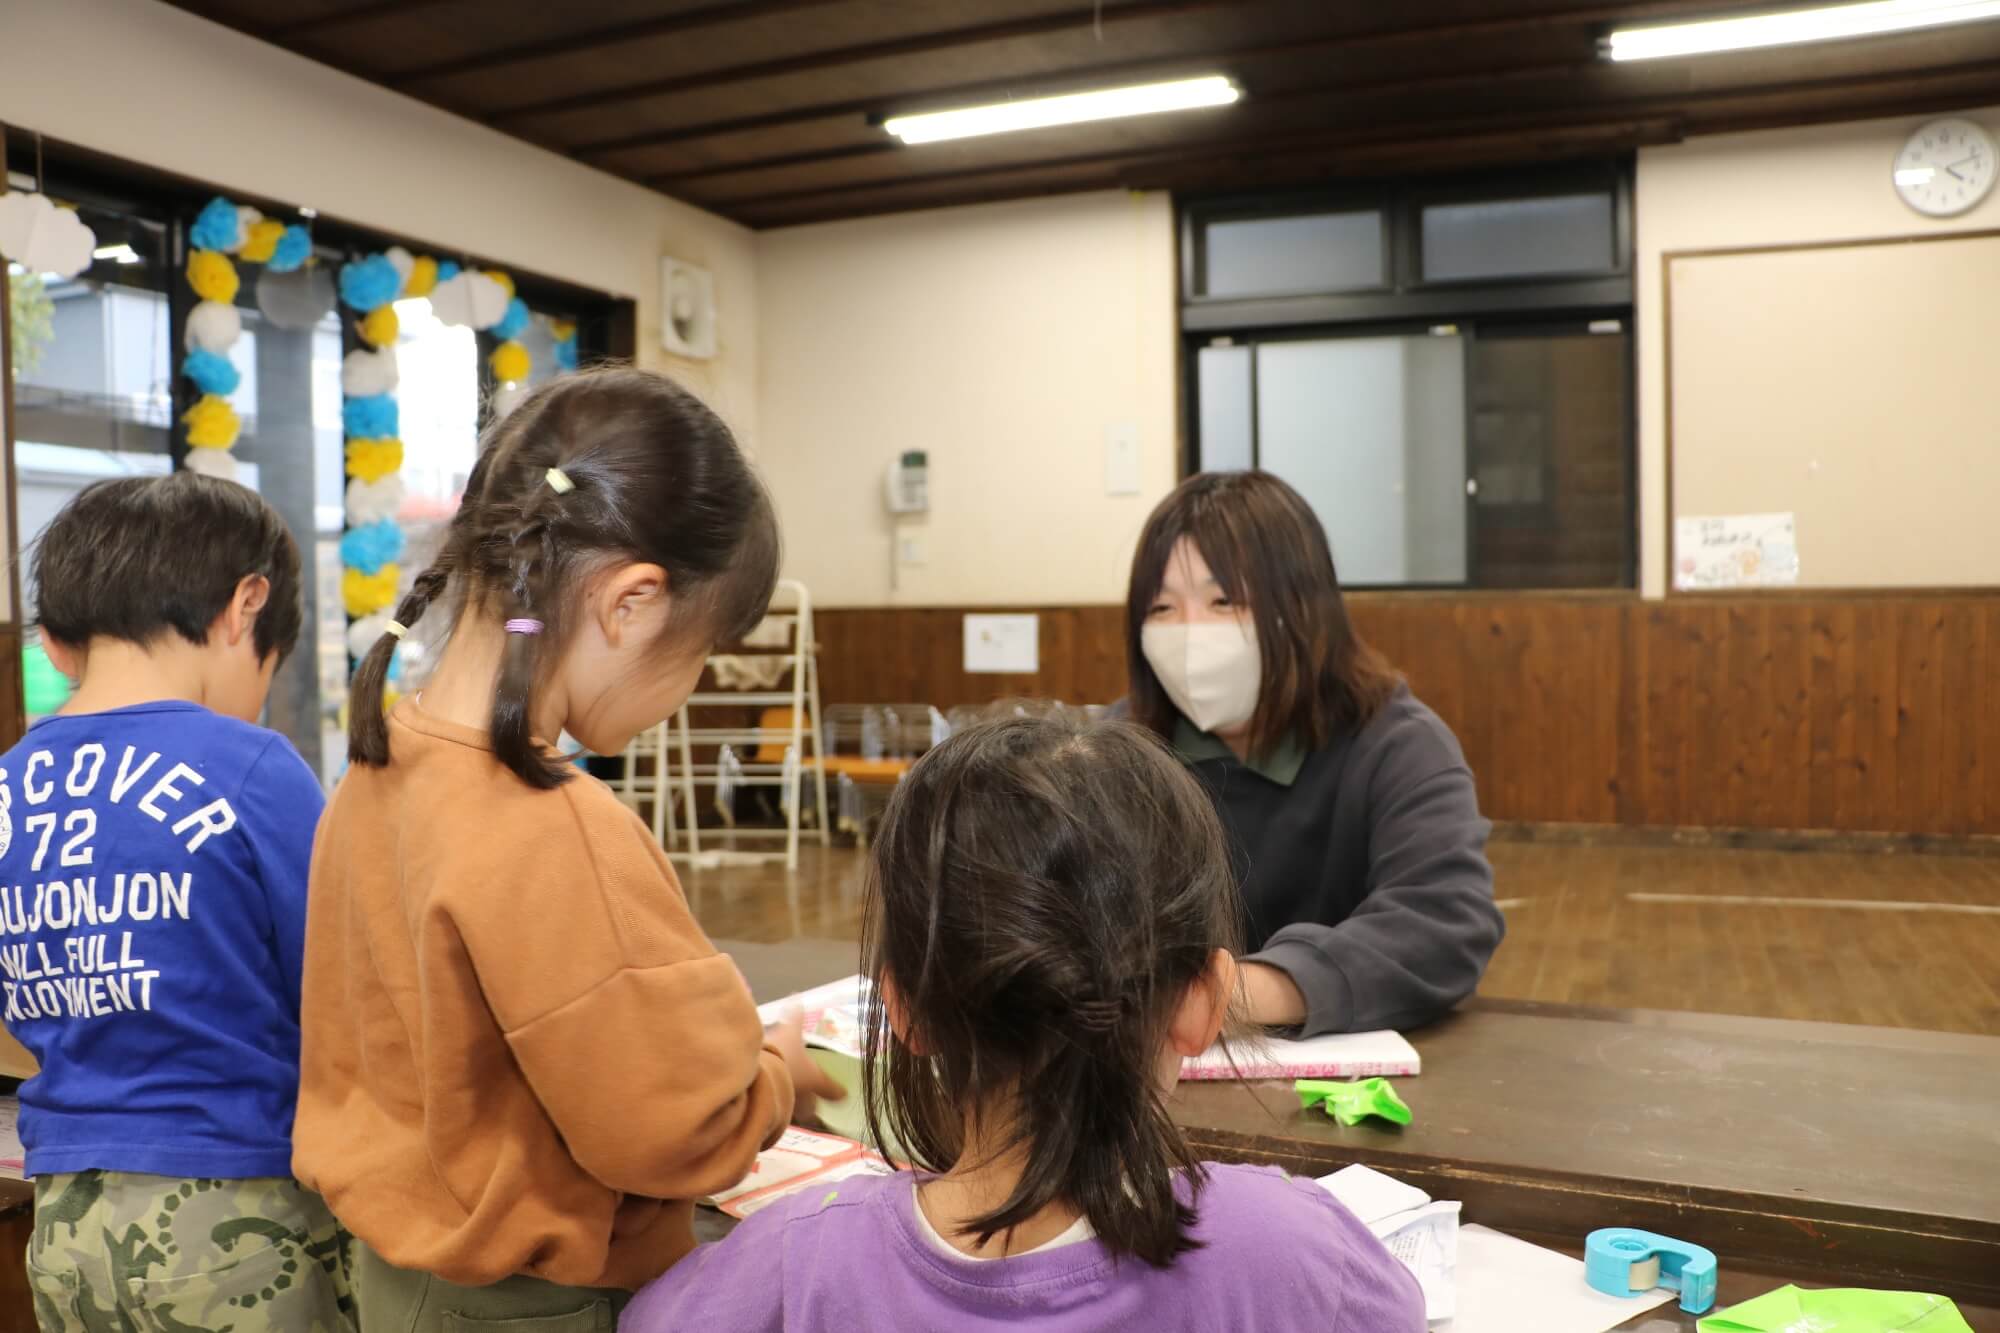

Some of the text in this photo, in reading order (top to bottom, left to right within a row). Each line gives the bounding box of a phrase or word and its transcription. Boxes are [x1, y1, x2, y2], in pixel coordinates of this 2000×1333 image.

[26, 808, 97, 871] 72
[0, 872, 192, 936] UJONJON
[65, 931, 144, 974] FULL
